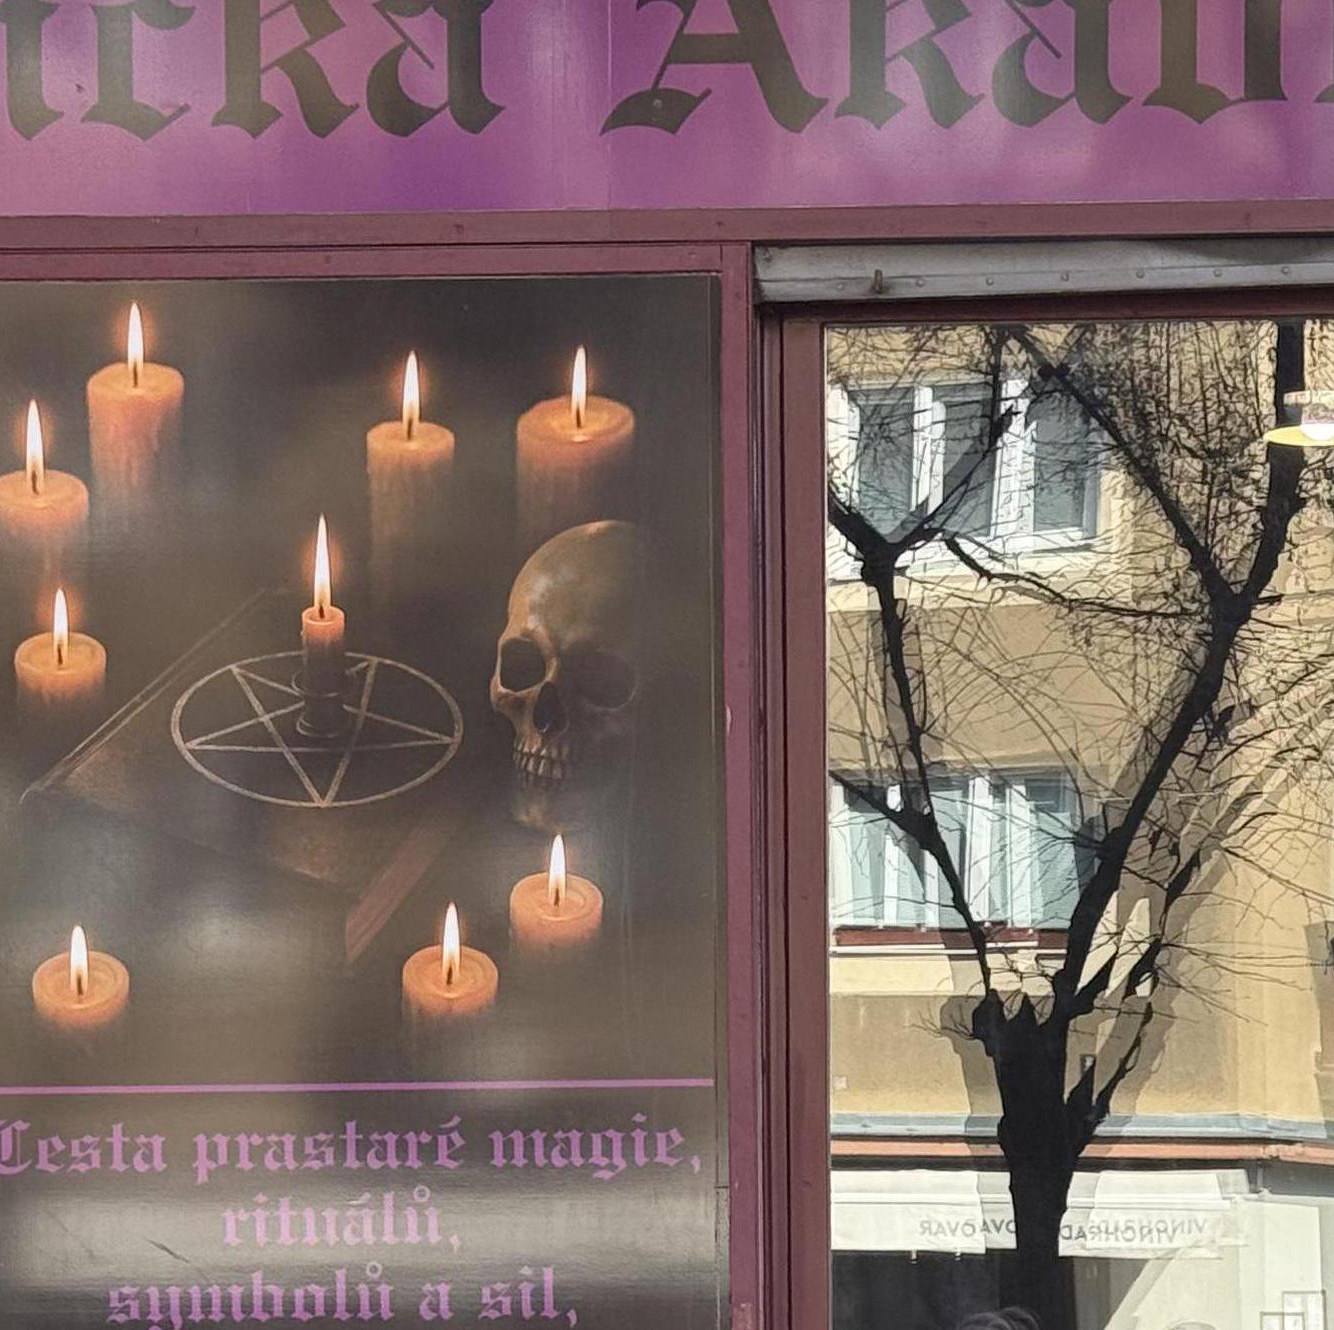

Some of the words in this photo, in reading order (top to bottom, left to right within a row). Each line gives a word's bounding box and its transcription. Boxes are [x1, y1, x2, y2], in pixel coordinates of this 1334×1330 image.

[192, 1115, 466, 1185] prastaré
[488, 1112, 701, 1181] magie,
[221, 1185, 462, 1254] rituálů,
[417, 1280, 454, 1322] a
